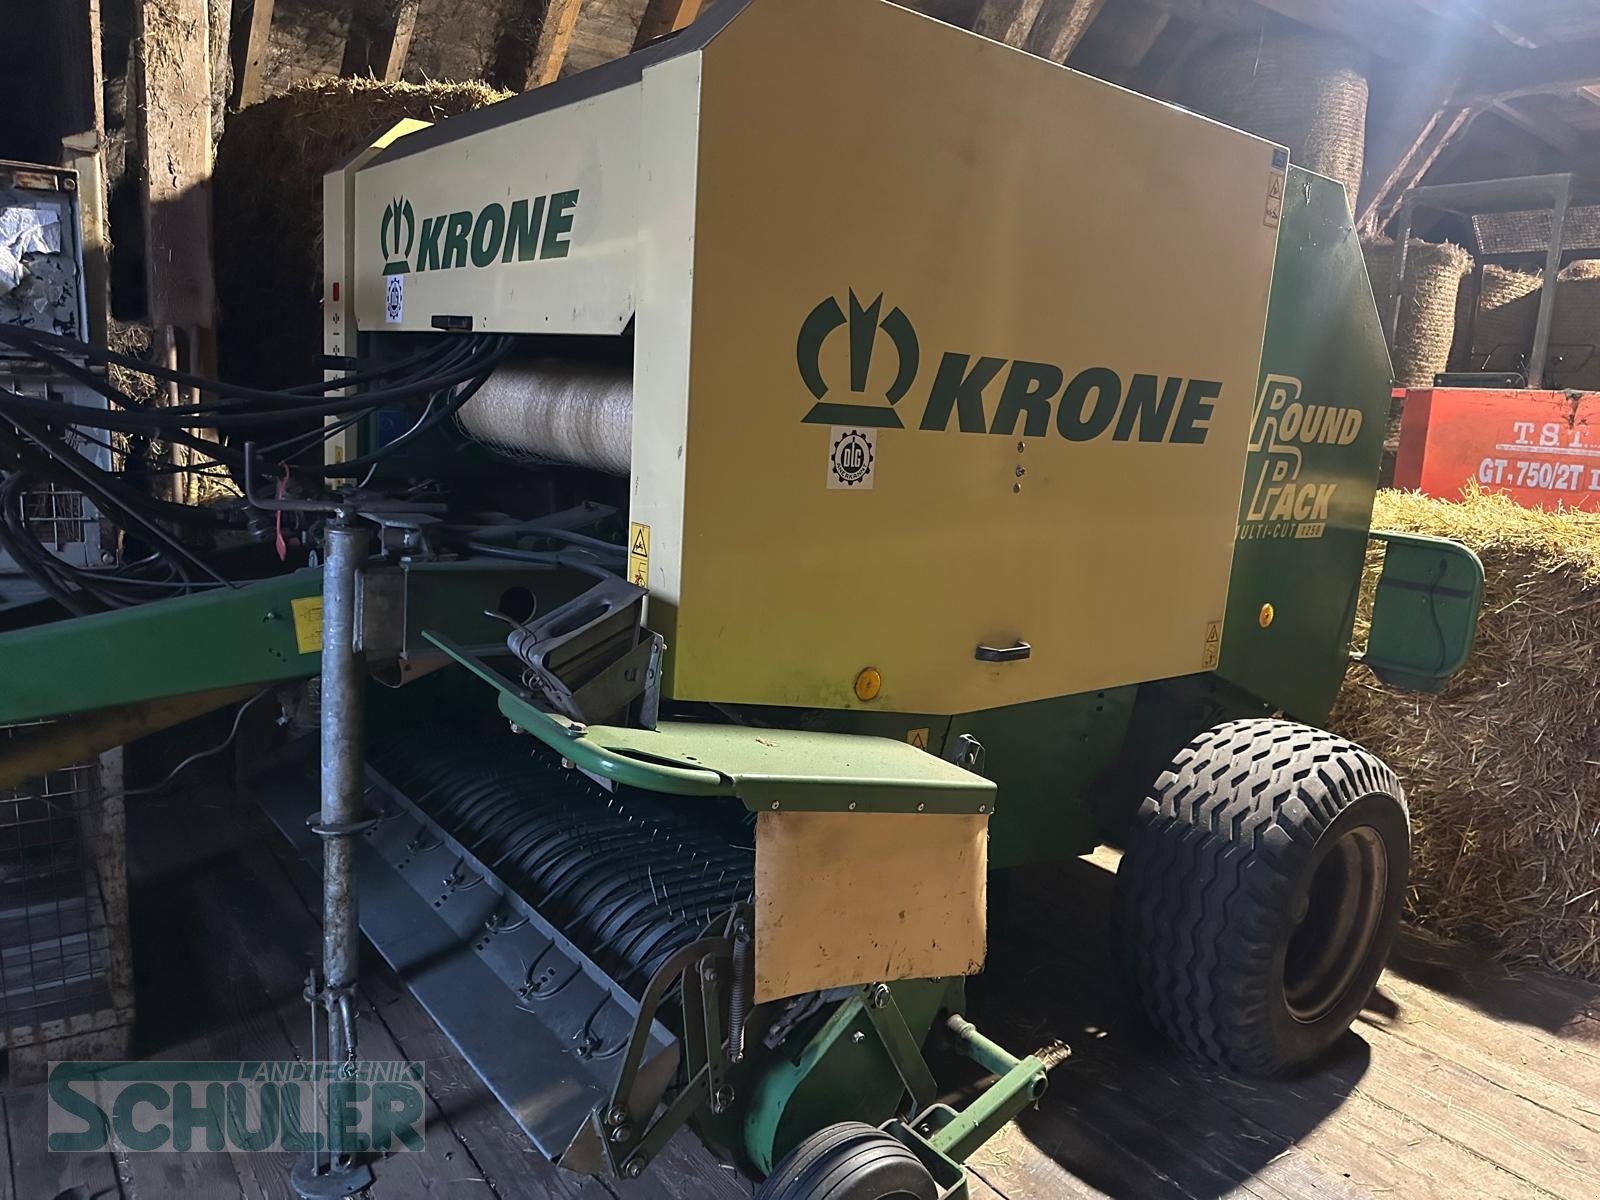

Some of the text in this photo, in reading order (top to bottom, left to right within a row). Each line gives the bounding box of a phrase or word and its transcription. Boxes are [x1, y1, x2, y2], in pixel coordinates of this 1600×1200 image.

[416, 189, 580, 272] KRONE
[919, 351, 1223, 445] KRONE
[1248, 373, 1363, 452] ROUND
[1246, 450, 1337, 521] PACK
[1236, 522, 1296, 540] ULTI-CUT
